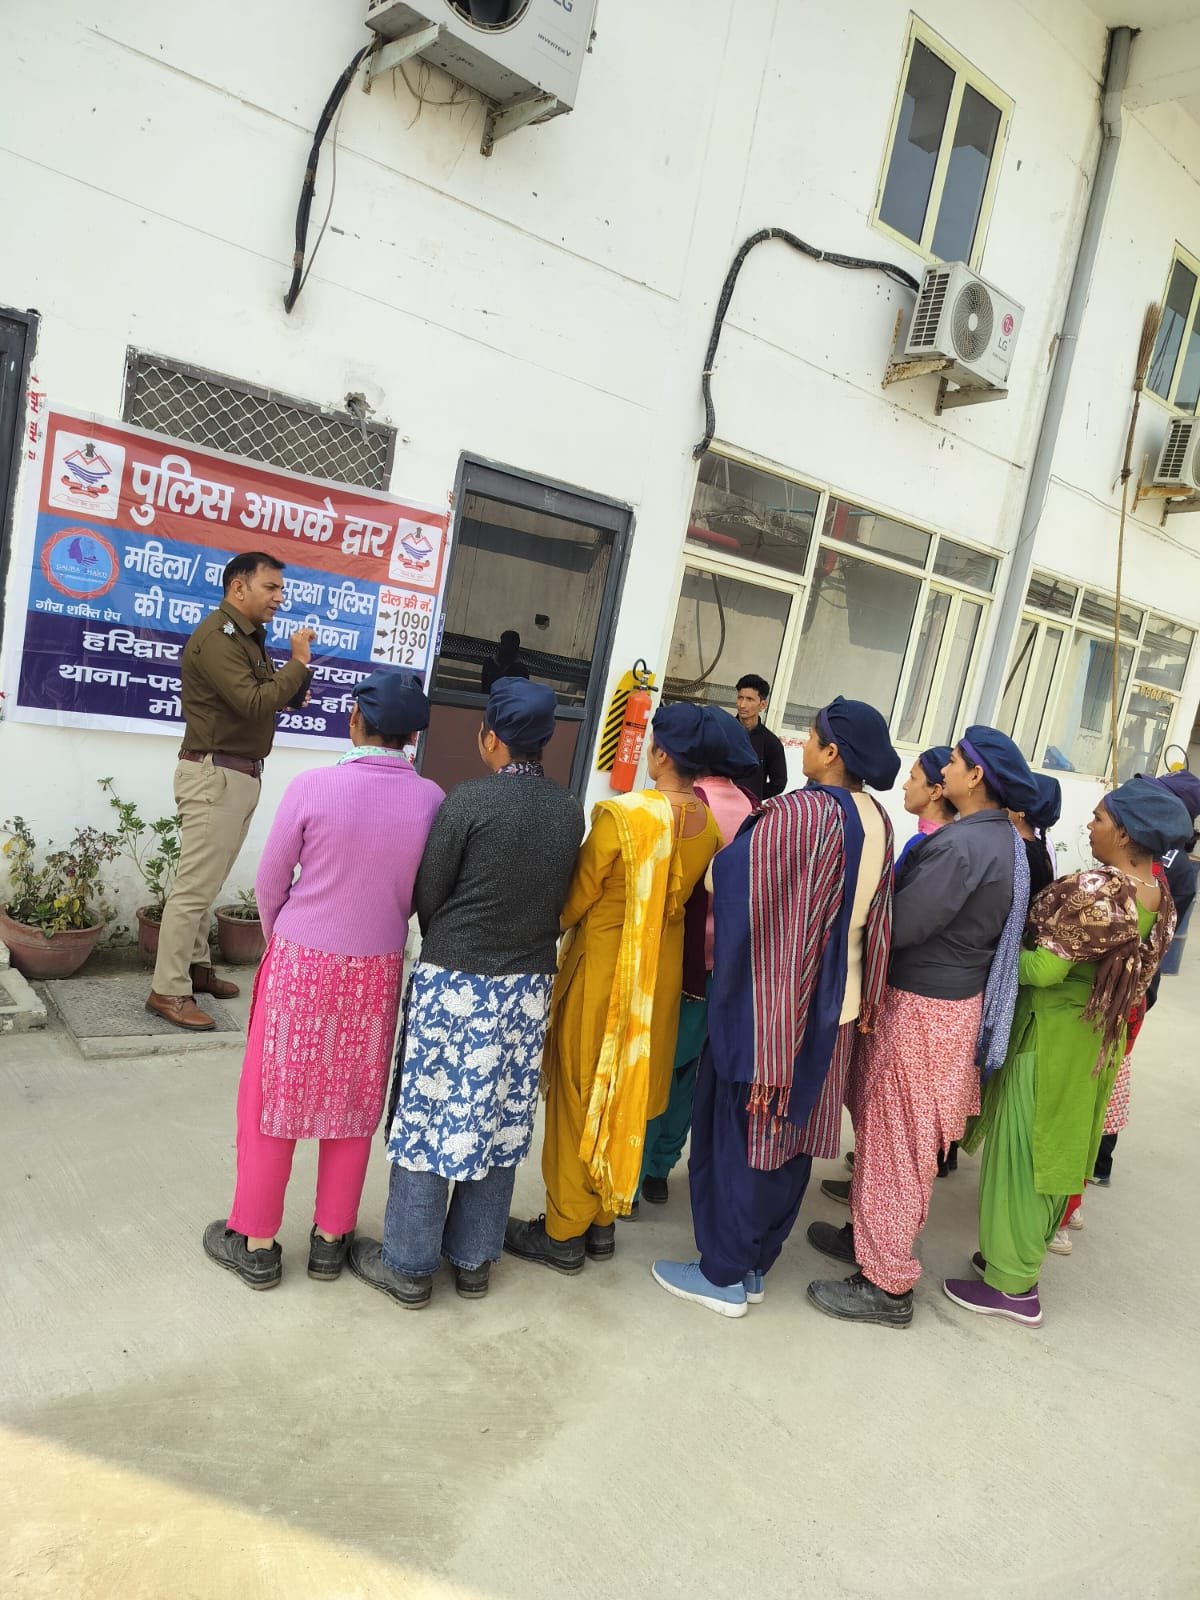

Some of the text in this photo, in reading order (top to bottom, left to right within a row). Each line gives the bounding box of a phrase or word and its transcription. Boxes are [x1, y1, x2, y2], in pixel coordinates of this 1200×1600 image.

[998, 337, 1008, 352] LG
[129, 454, 392, 557] पुलिस आपके द्वार
[35, 598, 122, 622] गौरा शक्ति ऐप
[134, 585, 164, 619] की
[168, 598, 204, 624] एक
[326, 581, 376, 620] पुलिस
[380, 589, 401, 607] टोल
[403, 594, 418, 609] फ्री
[393, 609, 430, 632] 1090
[82, 628, 183, 660] हरिद्वार
[390, 627, 427, 649] 1930
[387, 645, 415, 665] 112
